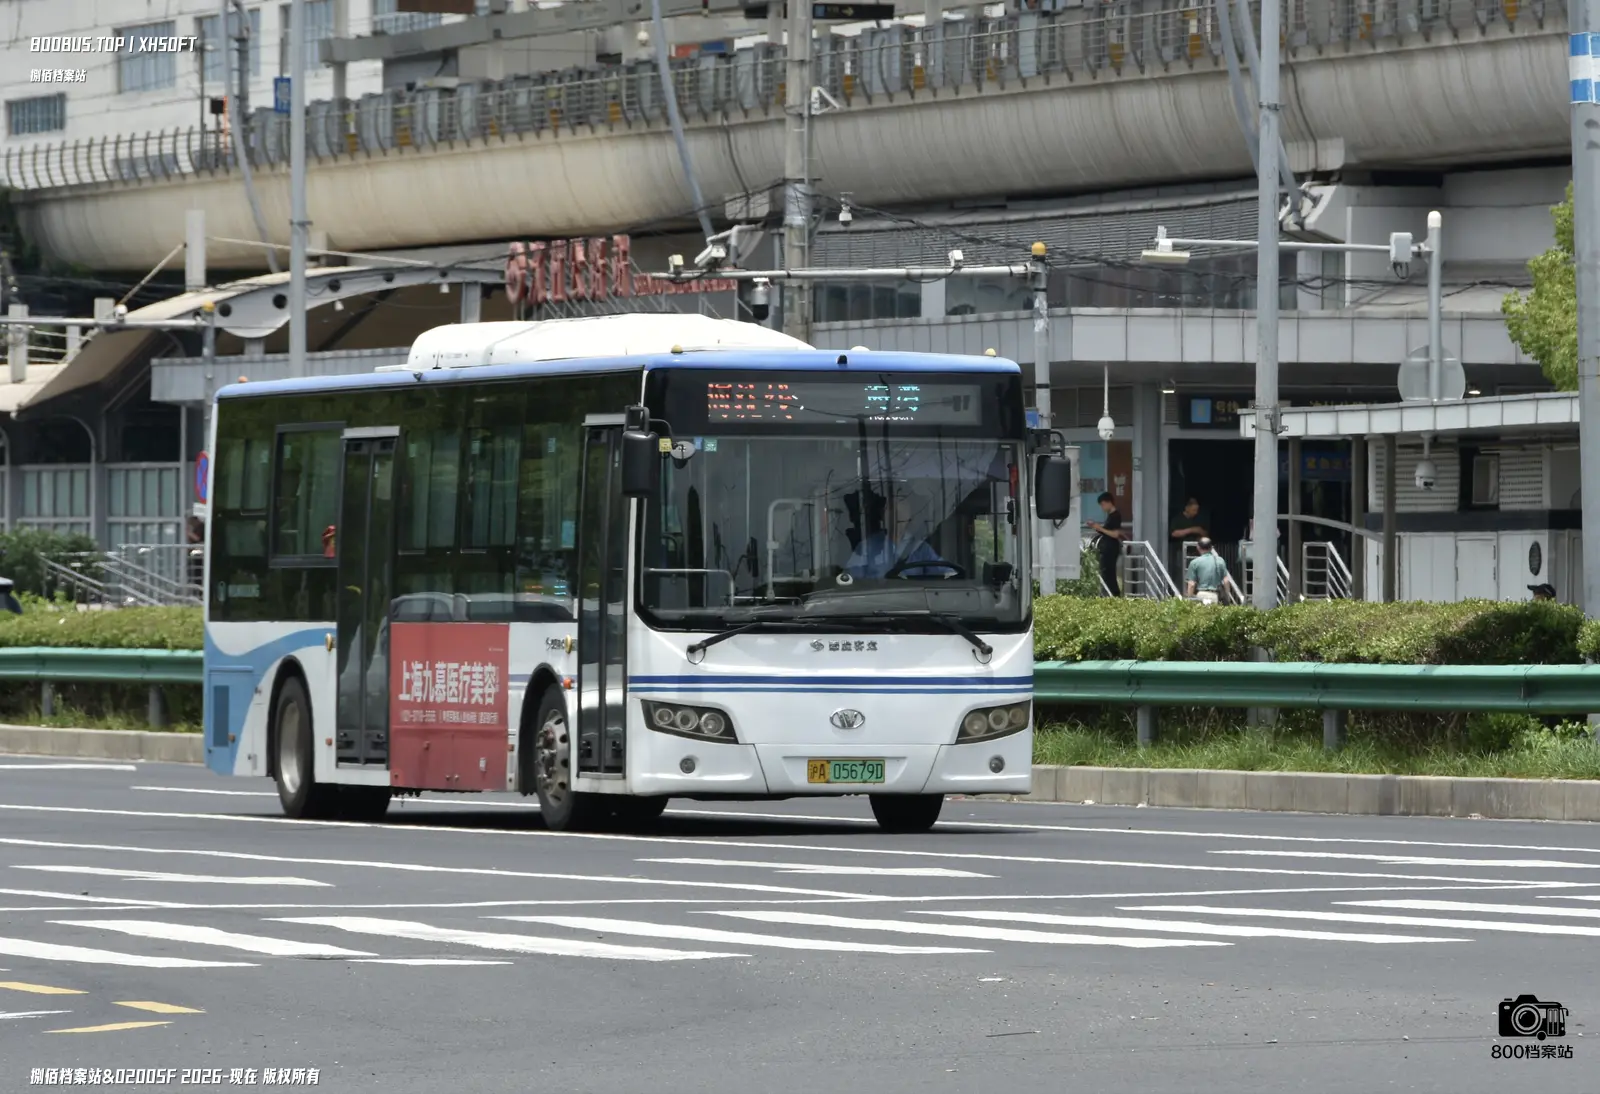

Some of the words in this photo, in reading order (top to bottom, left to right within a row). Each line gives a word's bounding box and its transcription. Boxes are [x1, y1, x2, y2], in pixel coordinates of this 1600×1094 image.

[398, 660, 497, 705] 上海九慕医疗美容
